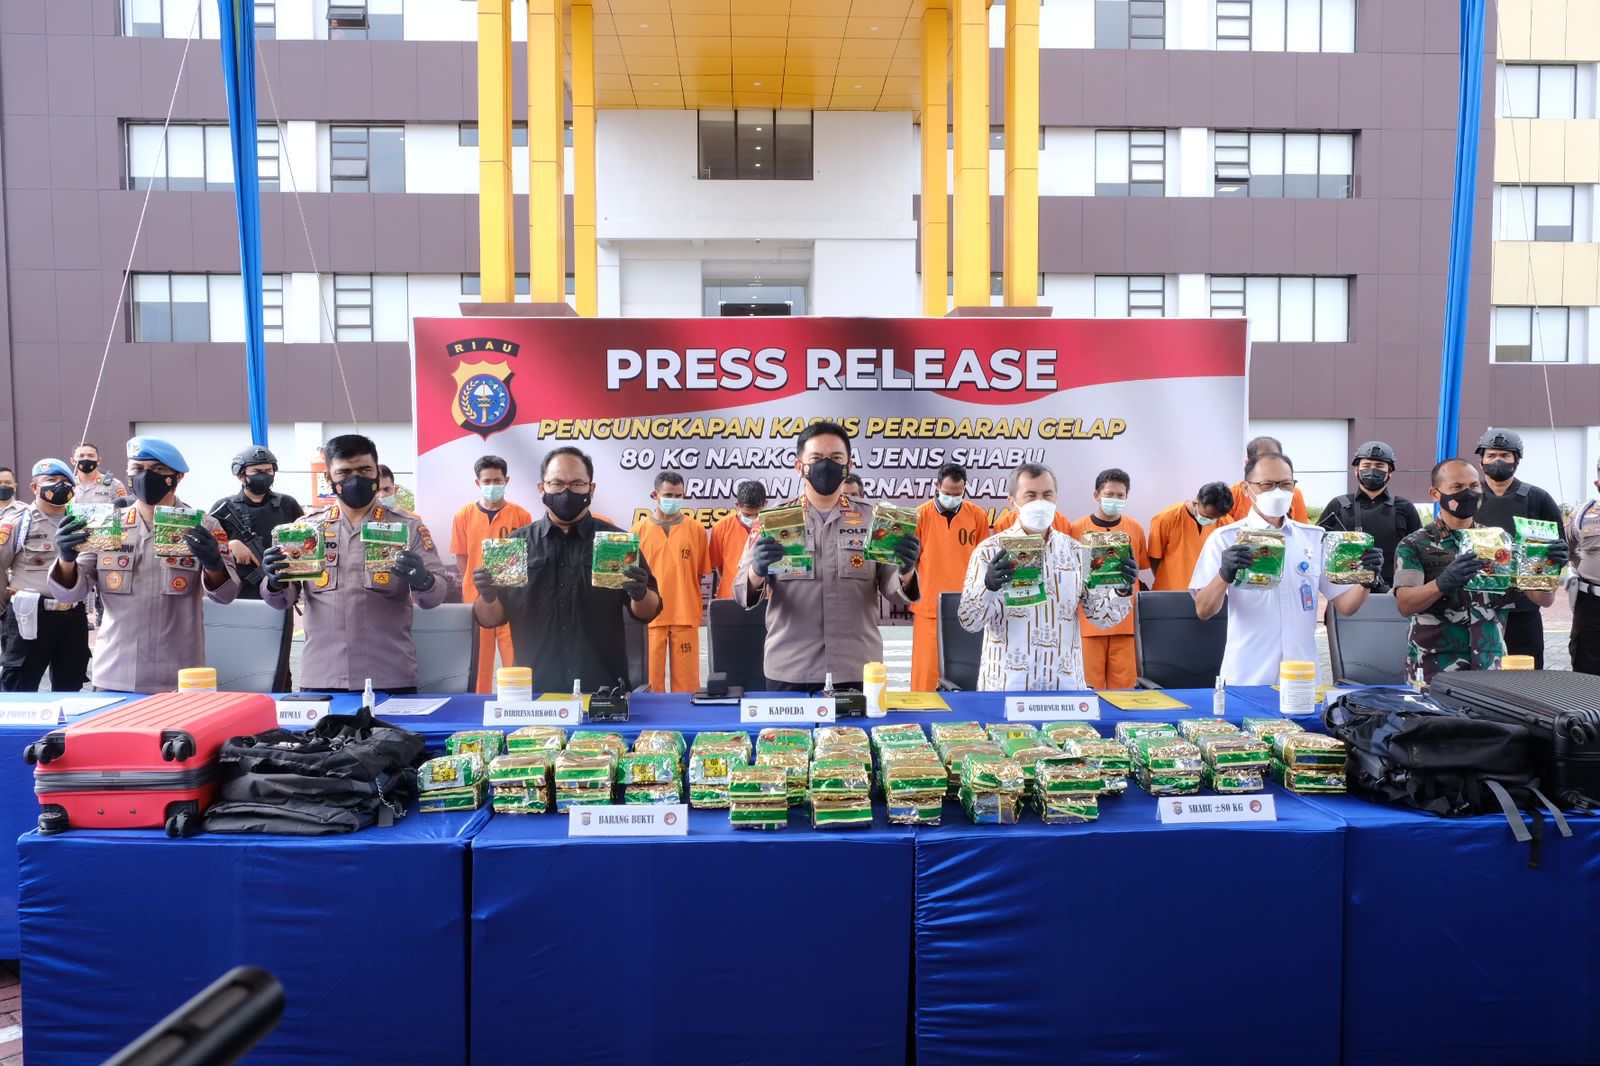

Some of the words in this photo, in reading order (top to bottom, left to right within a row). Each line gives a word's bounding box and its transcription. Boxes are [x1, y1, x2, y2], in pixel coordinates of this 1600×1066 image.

[454, 341, 513, 354] RIAU
[606, 347, 788, 391] PRESS
[806, 348, 1058, 391] RELEASE
[537, 416, 764, 439] PENGUNGKAPAN
[769, 416, 860, 439] KAS
[865, 416, 1032, 440] PEREDARAN
[1038, 416, 1126, 440] GELAP
[620, 447, 655, 469] 80
[661, 447, 700, 469] KG
[705, 447, 862, 470] NARKOA
[867, 447, 945, 470] JENIS
[951, 447, 1045, 470] SHABU
[958, 527, 977, 546] 06
[768, 705, 805, 716] KAPOLDA
[1188, 803, 1213, 814] SHABU
[1233, 802, 1244, 812] KG
[598, 814, 630, 825] BARANG
[631, 814, 656, 825] BUKTI
